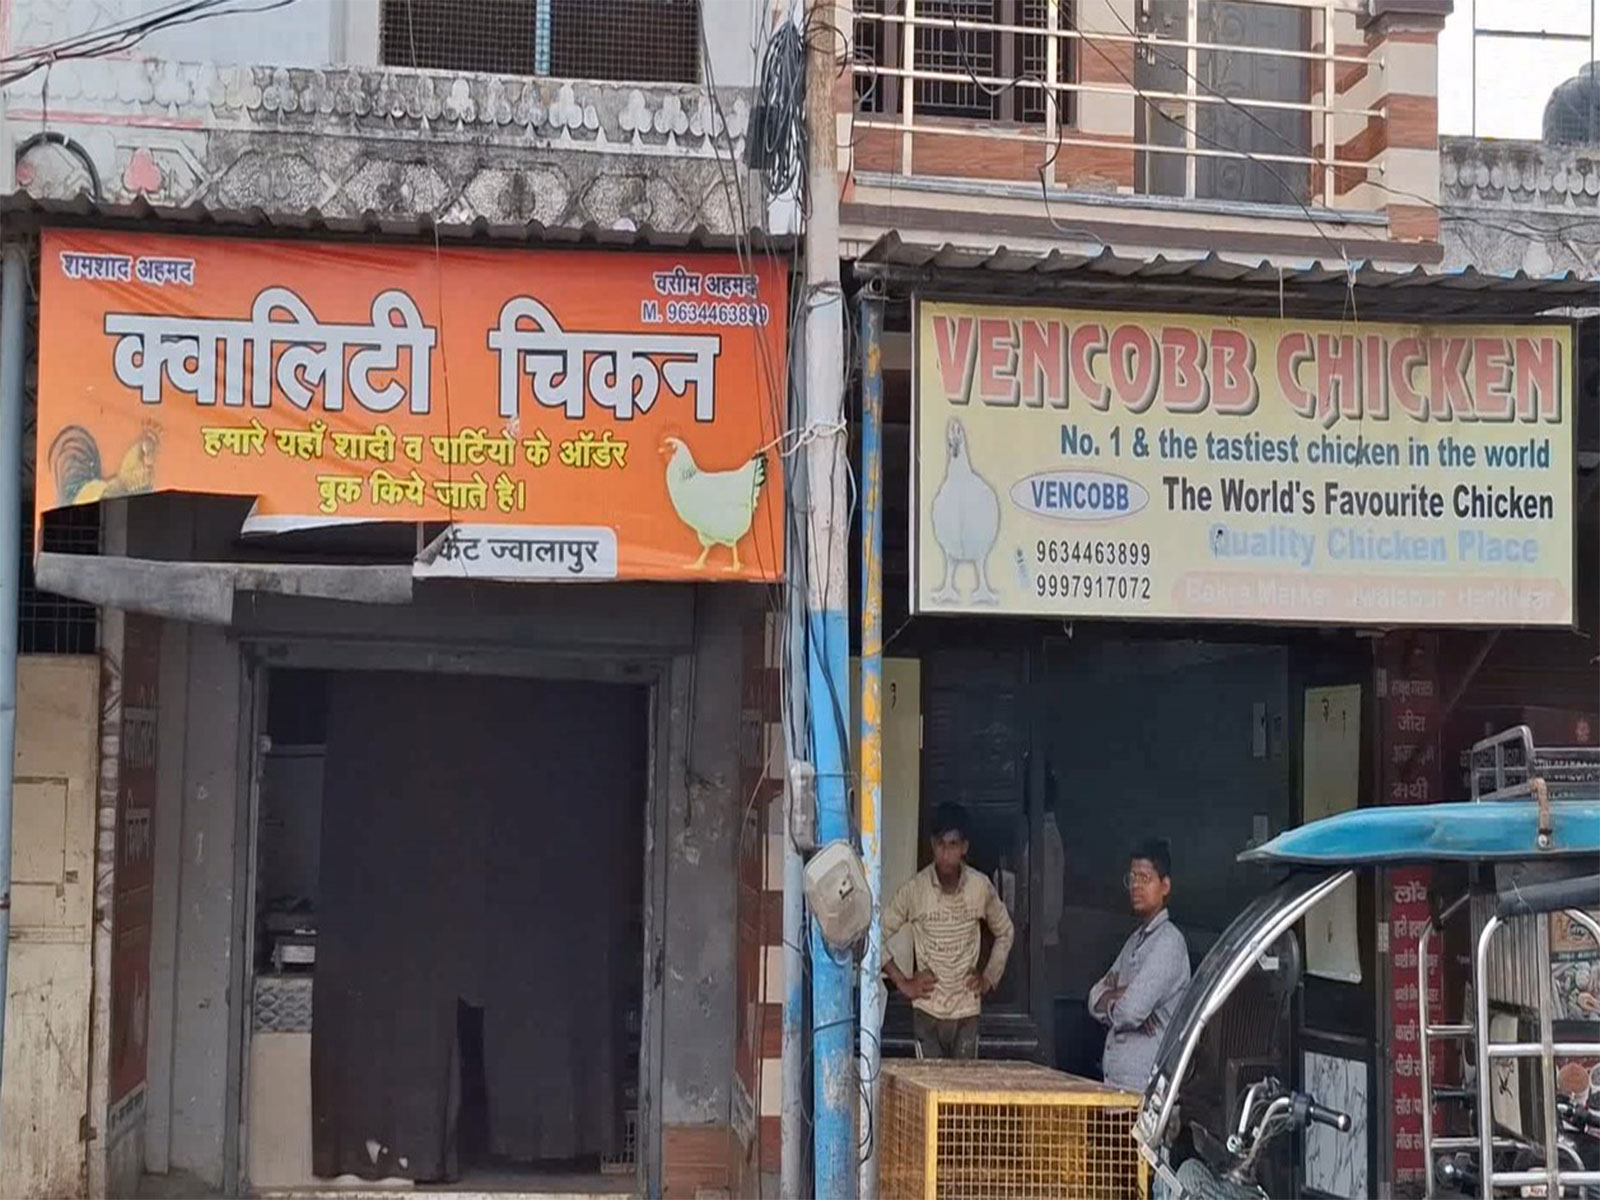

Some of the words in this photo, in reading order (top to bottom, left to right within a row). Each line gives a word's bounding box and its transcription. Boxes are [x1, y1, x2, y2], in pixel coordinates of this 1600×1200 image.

[60, 250, 133, 282] शमशाद
[136, 256, 195, 286] अहमद
[653, 265, 702, 296] वसीम
[641, 299, 664, 324] M.
[103, 286, 437, 415] क्वालिटी
[487, 295, 722, 422] चिकन
[932, 314, 1259, 416] VENCOBB
[1276, 331, 1562, 430] CHICKEN
[202, 419, 267, 456] हमारे
[274, 420, 325, 459] यहाँ
[332, 425, 396, 462] शादी
[403, 438, 424, 463] व
[522, 428, 550, 467] के
[559, 429, 628, 468] ऑर्डर
[1061, 425, 1099, 456] No.
[1110, 426, 1120, 456] 1
[1133, 428, 1149, 457] &
[1159, 429, 1197, 459] the
[1206, 431, 1299, 463] tastiest
[1306, 434, 1399, 466] chicken
[1408, 436, 1429, 467] in
[1438, 437, 1475, 468] the
[1485, 438, 1549, 468] world
[316, 473, 362, 513] बुक
[370, 469, 425, 508] किये
[433, 473, 490, 511] जाते
[1031, 480, 1129, 510] VENCOBB
[1163, 476, 1212, 510] The
[1220, 478, 1315, 515] World's
[1324, 482, 1444, 518] Favourite
[1453, 484, 1553, 519] Chicken
[487, 539, 599, 573] ज्वालापुर
[1037, 540, 1150, 566] 9634463899
[1209, 522, 1316, 567] Quality
[1328, 526, 1446, 562] Chicken
[1458, 529, 1540, 564] Place
[1037, 574, 1150, 599] 9997917072
